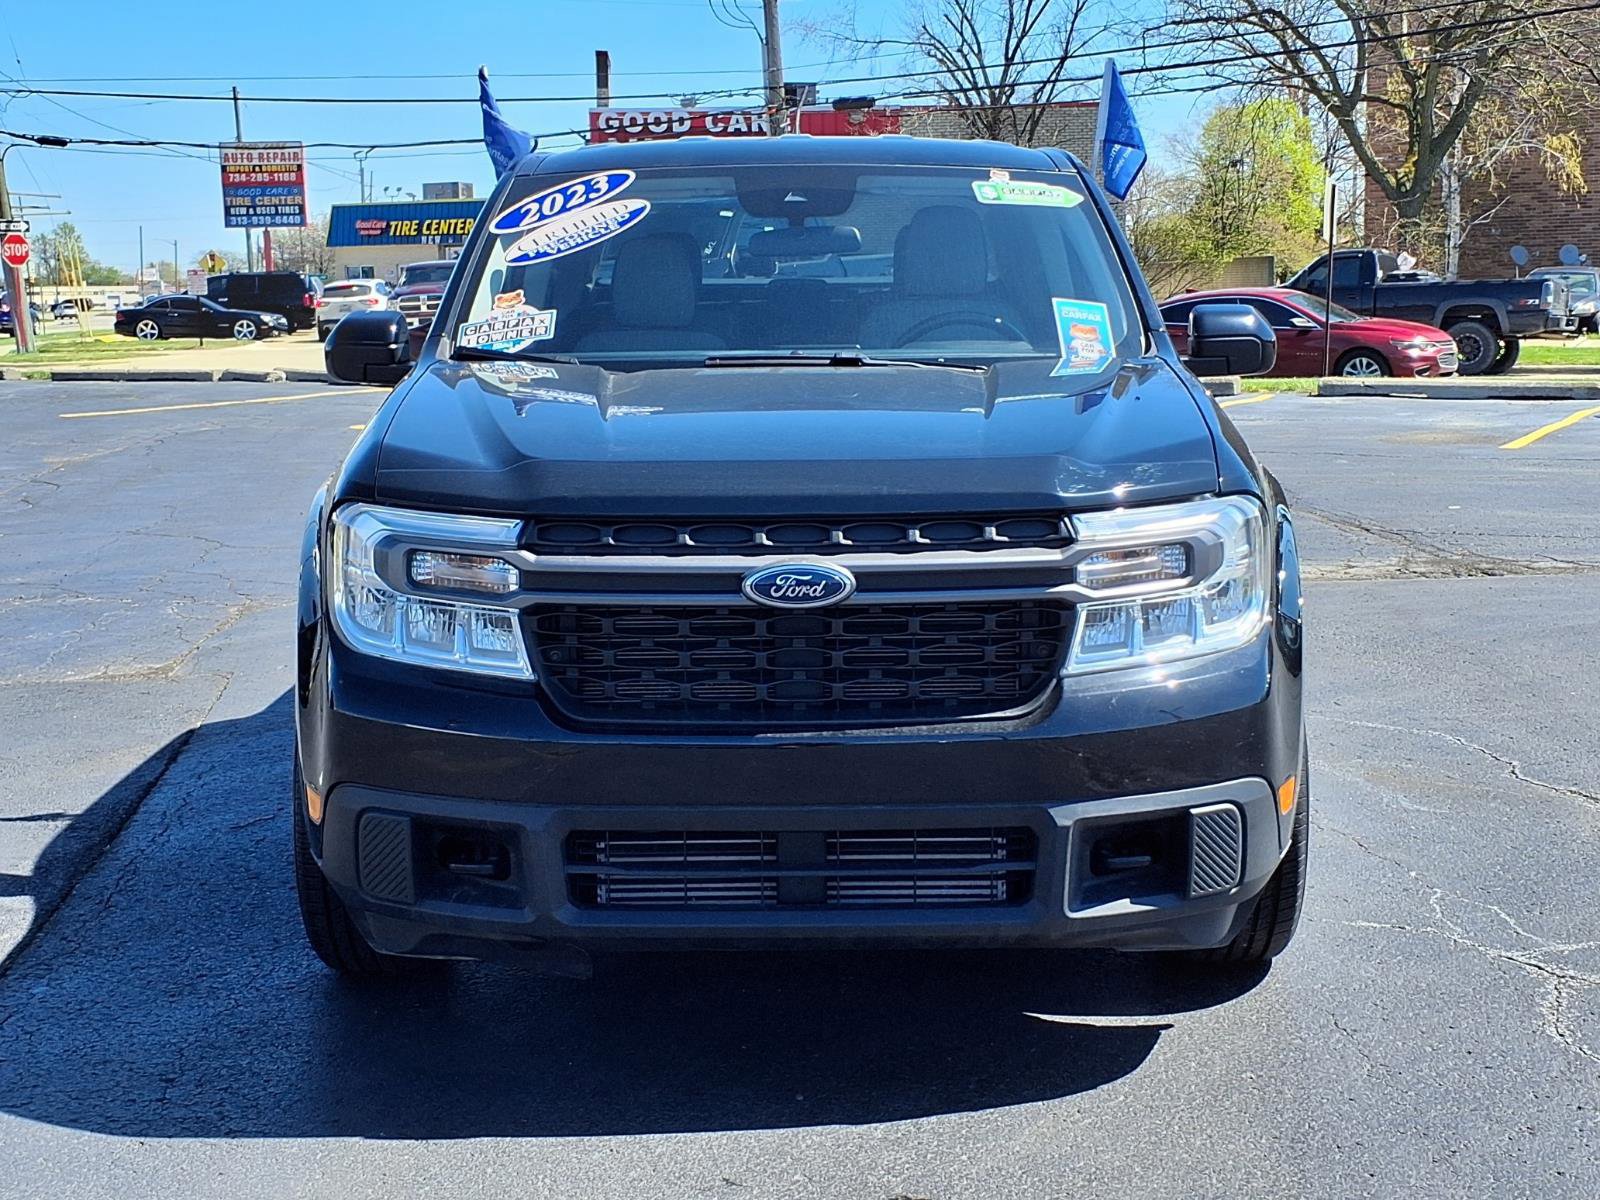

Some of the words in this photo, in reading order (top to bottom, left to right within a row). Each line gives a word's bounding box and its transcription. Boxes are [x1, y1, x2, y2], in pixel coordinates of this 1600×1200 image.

[599, 112, 691, 133] GOOD
[705, 111, 790, 133] CAR
[223, 152, 253, 164] AUTO
[258, 151, 300, 163] REPAIR
[226, 165, 254, 173] IMPORT
[261, 165, 298, 173] DOMESTIC
[237, 188, 262, 196] GOOD
[266, 187, 290, 195] CARE
[225, 197, 252, 206] TIRE
[255, 196, 303, 205] CENTER
[518, 175, 609, 227] 2023
[230, 207, 247, 215] NEW
[256, 206, 275, 214] USED
[277, 206, 300, 214] TIRES
[390, 220, 419, 236] TIRE
[422, 219, 475, 235] CENTER
[4, 243, 29, 257] STOP
[465, 317, 546, 336] CARFAX
[770, 574, 826, 597] Ford
